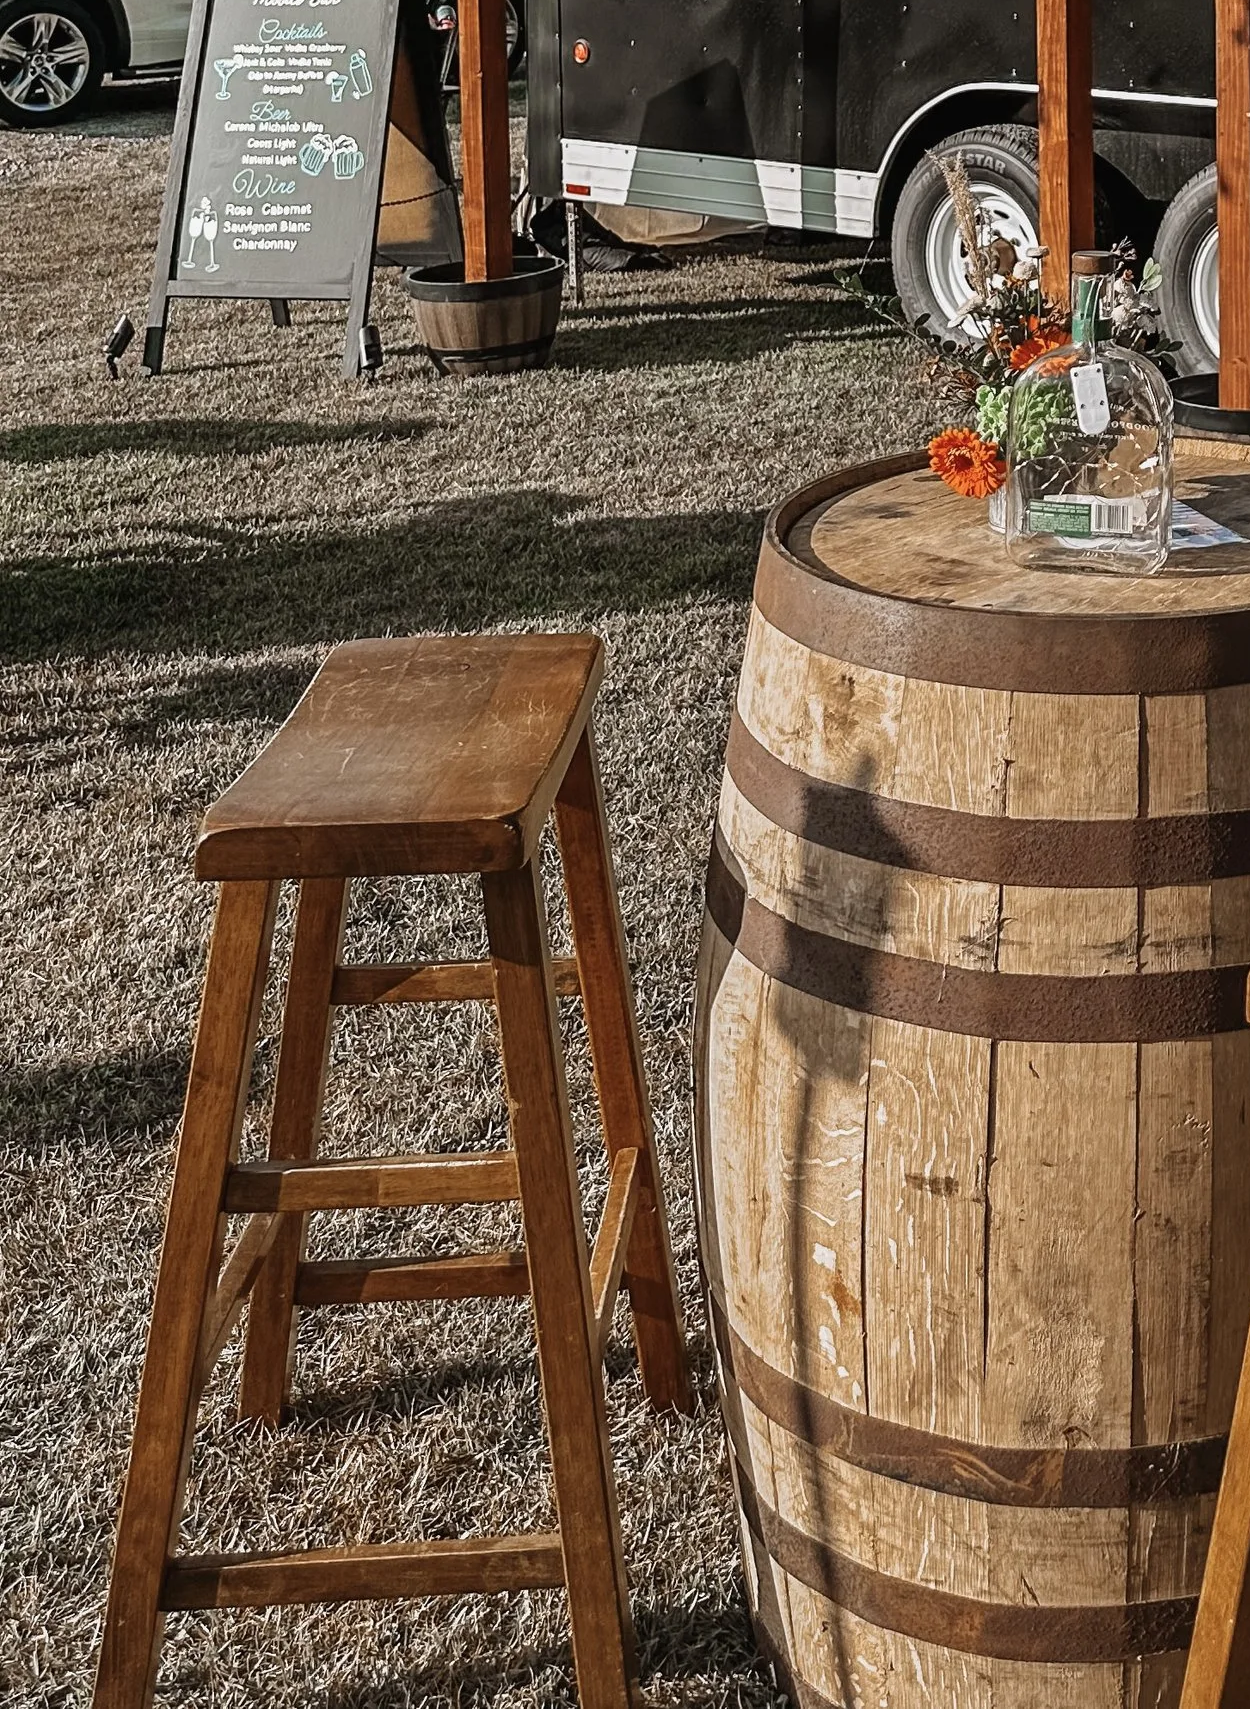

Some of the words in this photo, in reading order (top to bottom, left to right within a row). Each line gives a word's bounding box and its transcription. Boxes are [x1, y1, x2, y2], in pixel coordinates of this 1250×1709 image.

[259, 19, 327, 43] Cocktails
[250, 100, 291, 121] Beer
[224, 121, 256, 132] Corona
[259, 121, 301, 132] Michelob
[302, 122, 323, 132] Ultra
[247, 138, 272, 148] Coors
[274, 139, 296, 150] Light
[242, 155, 273, 165] Natural
[275, 155, 297, 166] Light
[233, 169, 295, 198] Wine
[225, 204, 253, 216] Rose
[262, 203, 311, 215] Cabernet
[223, 221, 277, 235] Sauvignon
[280, 221, 310, 232] Blanc
[233, 238, 297, 252] Chardonnay
